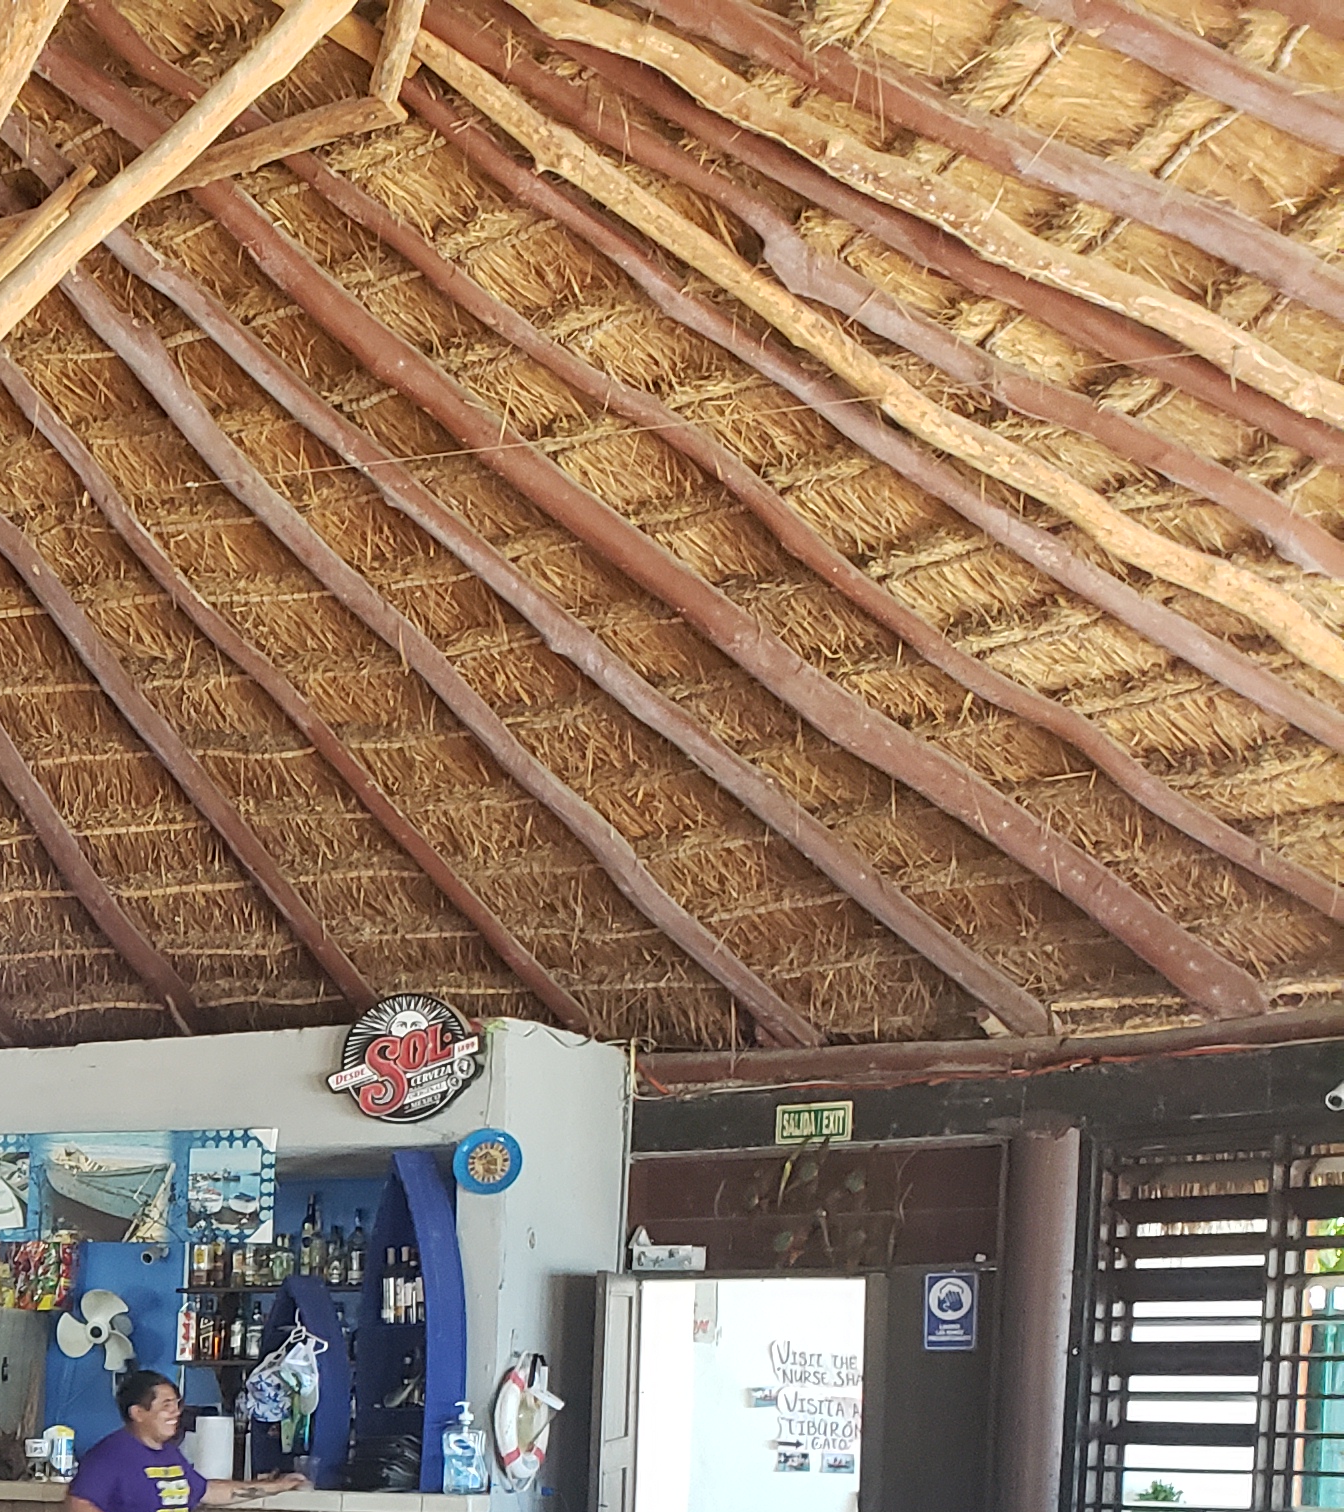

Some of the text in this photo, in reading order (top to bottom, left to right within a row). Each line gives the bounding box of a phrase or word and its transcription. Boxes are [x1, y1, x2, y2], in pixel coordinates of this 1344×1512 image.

[335, 1067, 366, 1086] DESDE
[410, 1064, 452, 1087] CERVEZA
[783, 1111, 815, 1136] SALIDA
[822, 1110, 844, 1134] EXIT
[776, 1341, 858, 1370] VISIT THE
[782, 1367, 829, 1385] NURSE
[784, 1391, 845, 1418] VISITA
